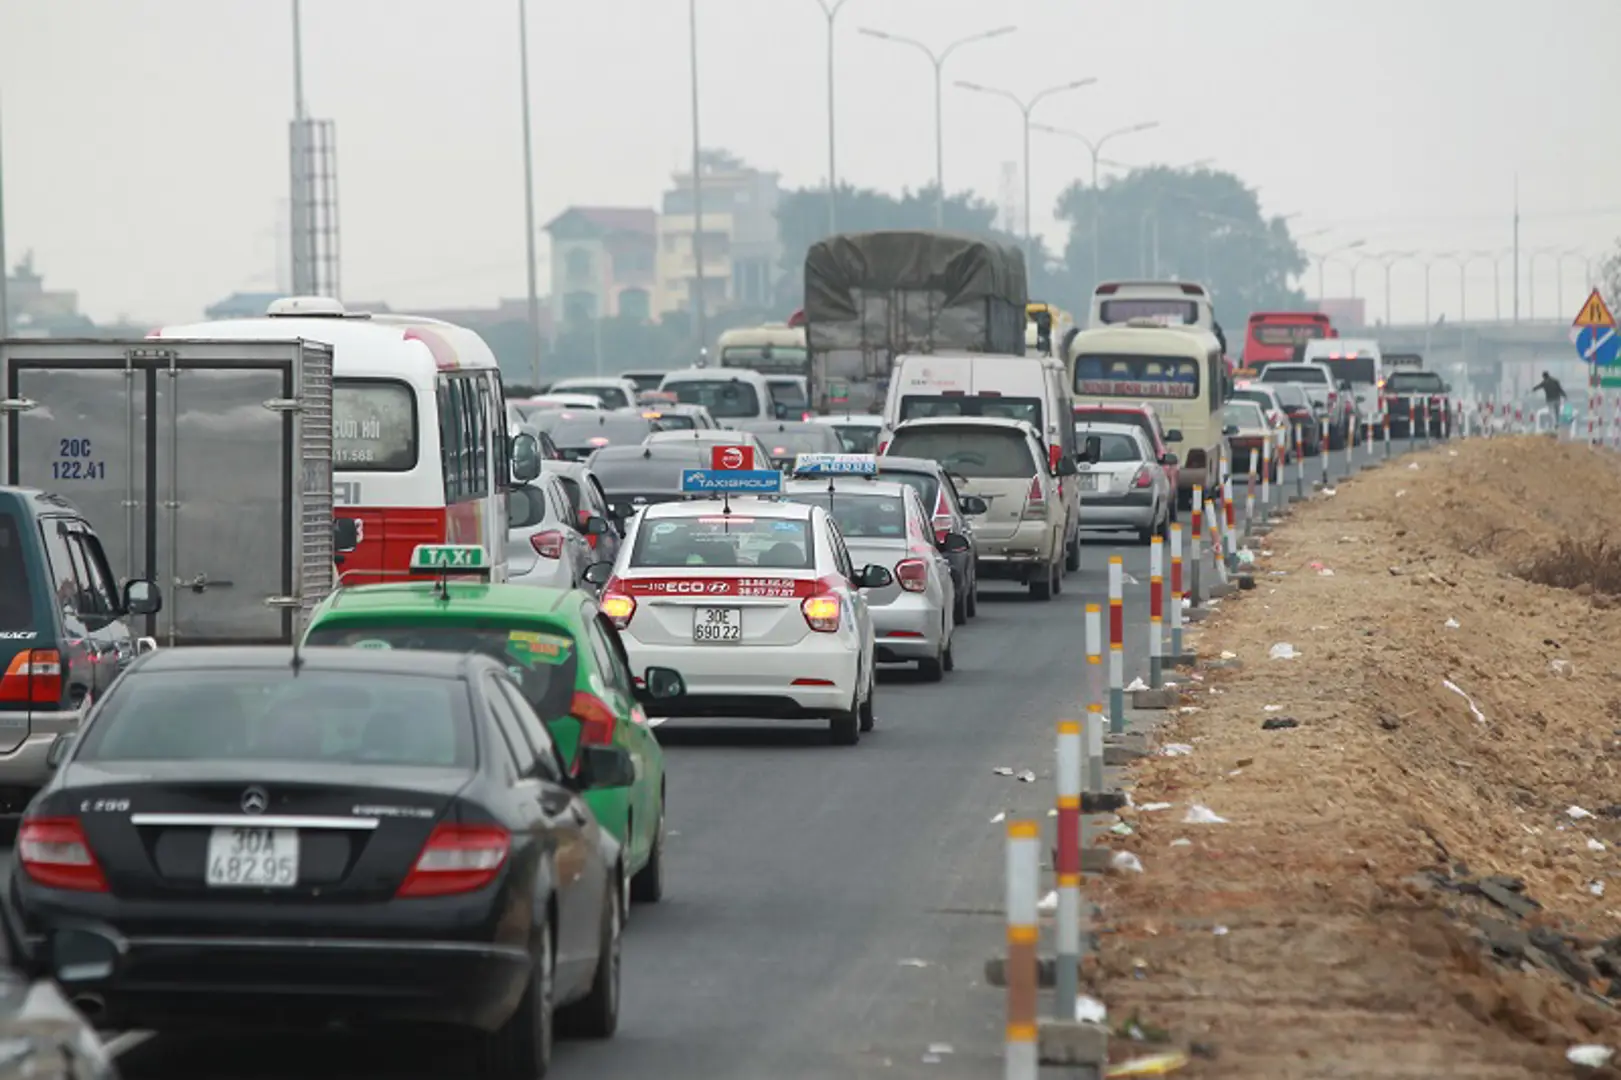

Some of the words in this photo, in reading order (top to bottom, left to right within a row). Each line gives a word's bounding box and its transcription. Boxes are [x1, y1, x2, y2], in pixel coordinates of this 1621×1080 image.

[60, 438, 91, 457] 20C
[52, 461, 105, 479] 122.41
[427, 549, 473, 565] TAXI
[665, 581, 705, 593] ECO
[705, 609, 731, 625] 30E
[231, 827, 274, 855] 30A
